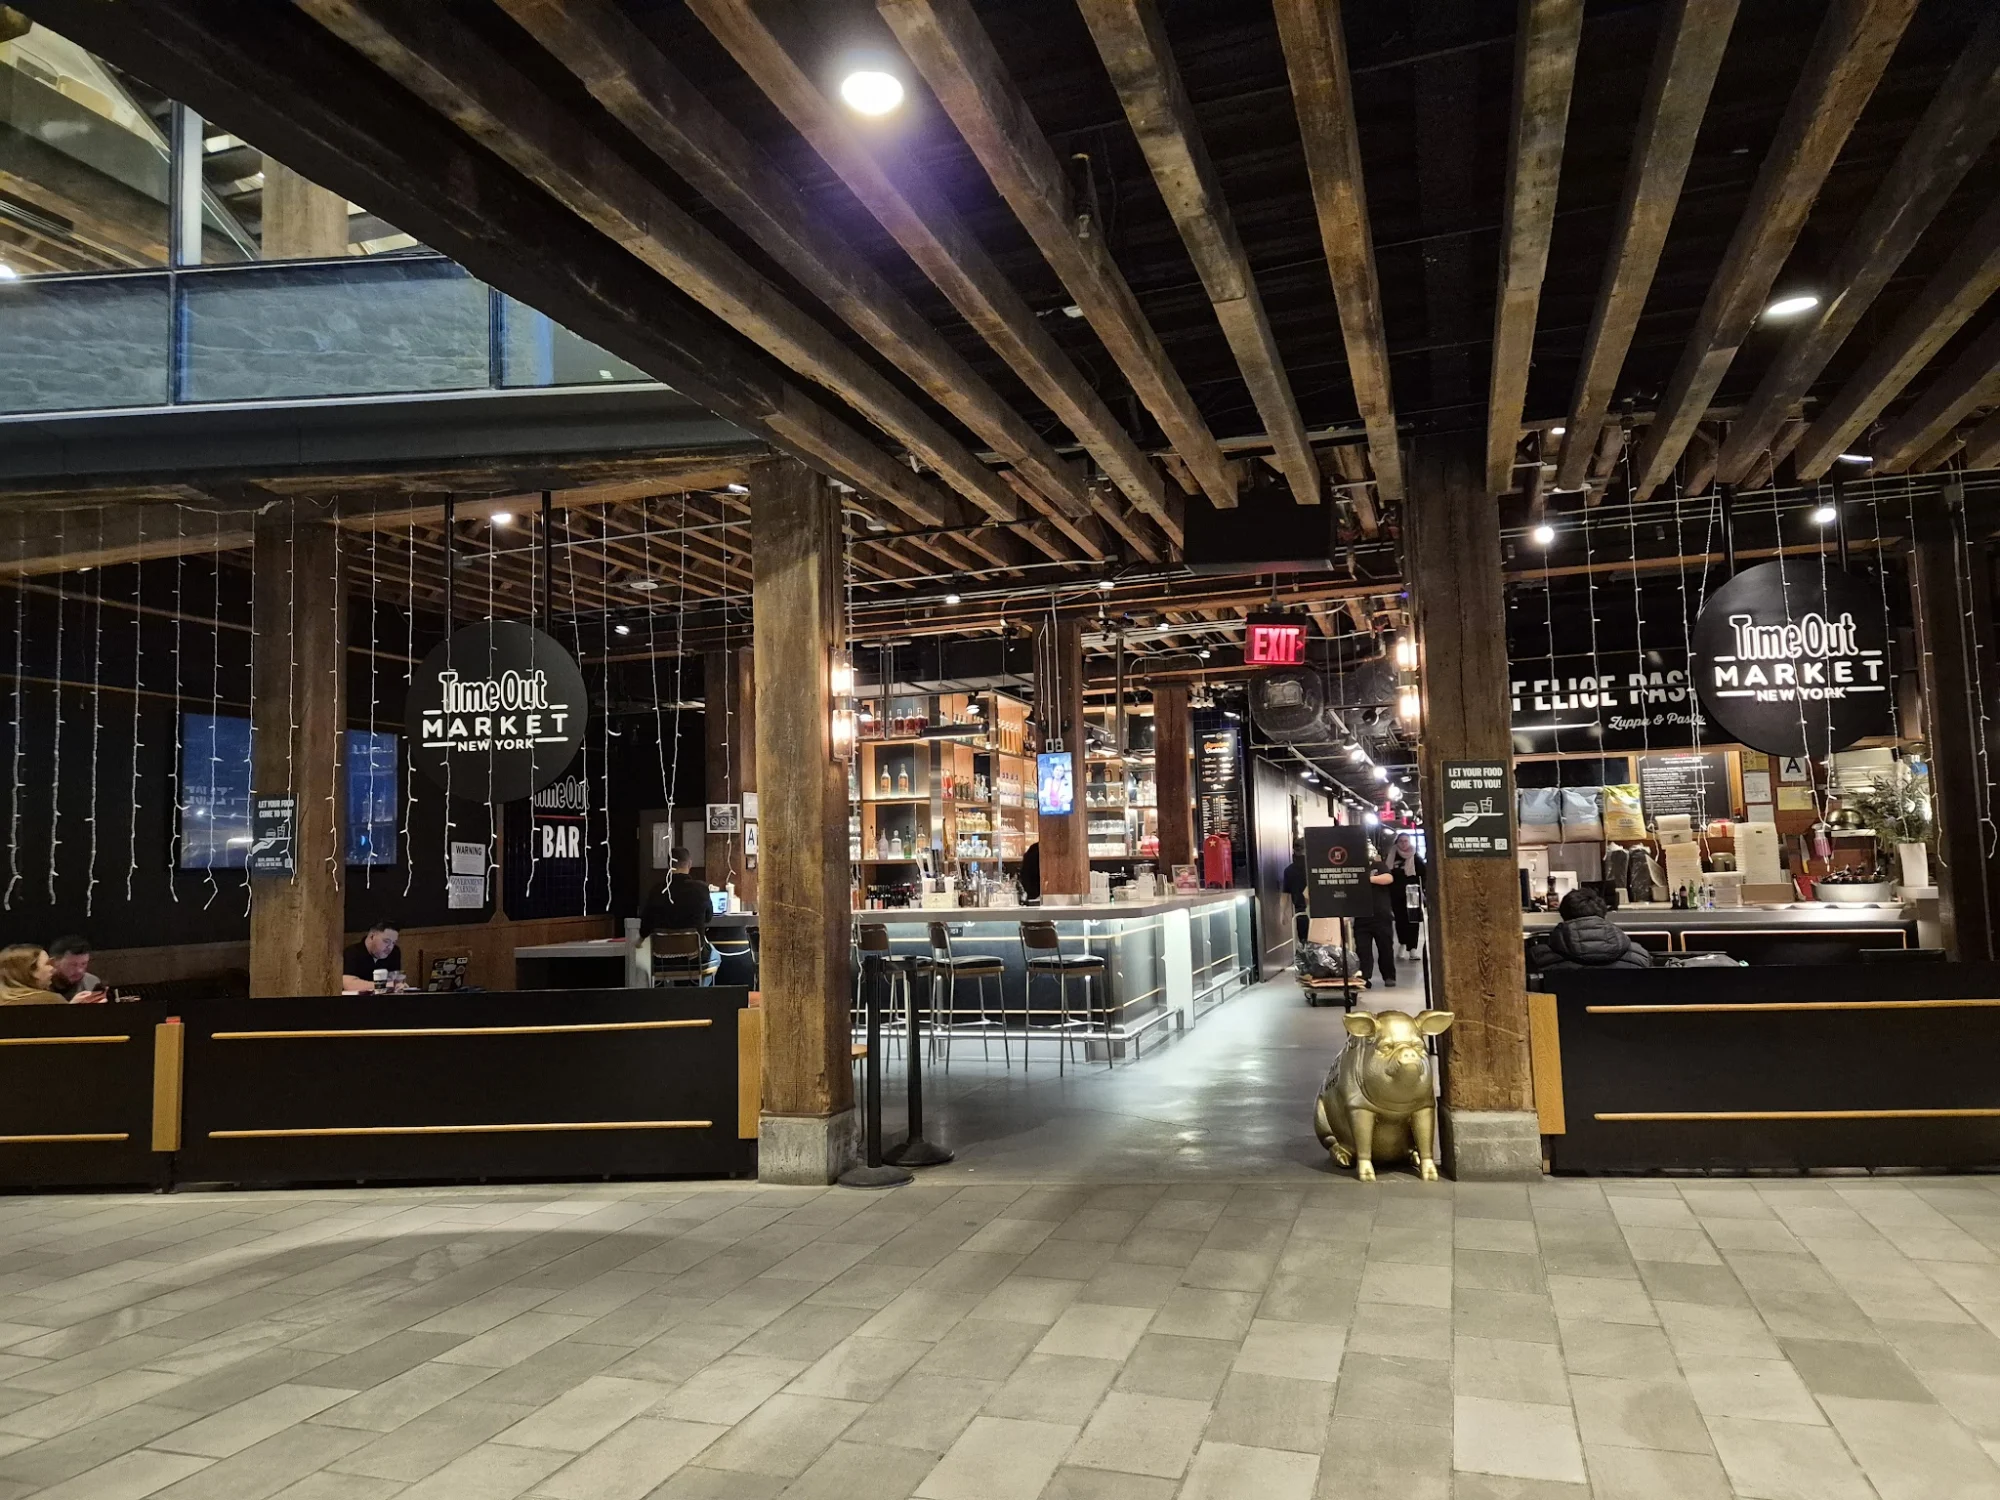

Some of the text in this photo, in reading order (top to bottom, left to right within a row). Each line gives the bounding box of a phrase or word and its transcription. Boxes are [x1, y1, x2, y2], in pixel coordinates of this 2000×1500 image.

[1253, 627, 1300, 662] EXIT
[1714, 660, 1884, 688] MARKET
[1756, 686, 1847, 702] NEW YORK
[422, 713, 569, 739] MARKET
[1608, 712, 1706, 731] Zuppa & Pasta
[457, 738, 535, 753] NEW YORK
[1448, 767, 1503, 778] LET YOUR FOOD
[1785, 757, 1802, 774] A
[1450, 779, 1502, 789] COME TO YOU!
[542, 824, 580, 859] BAR
[747, 828, 755, 846] A
[456, 844, 482, 856] WARNING
